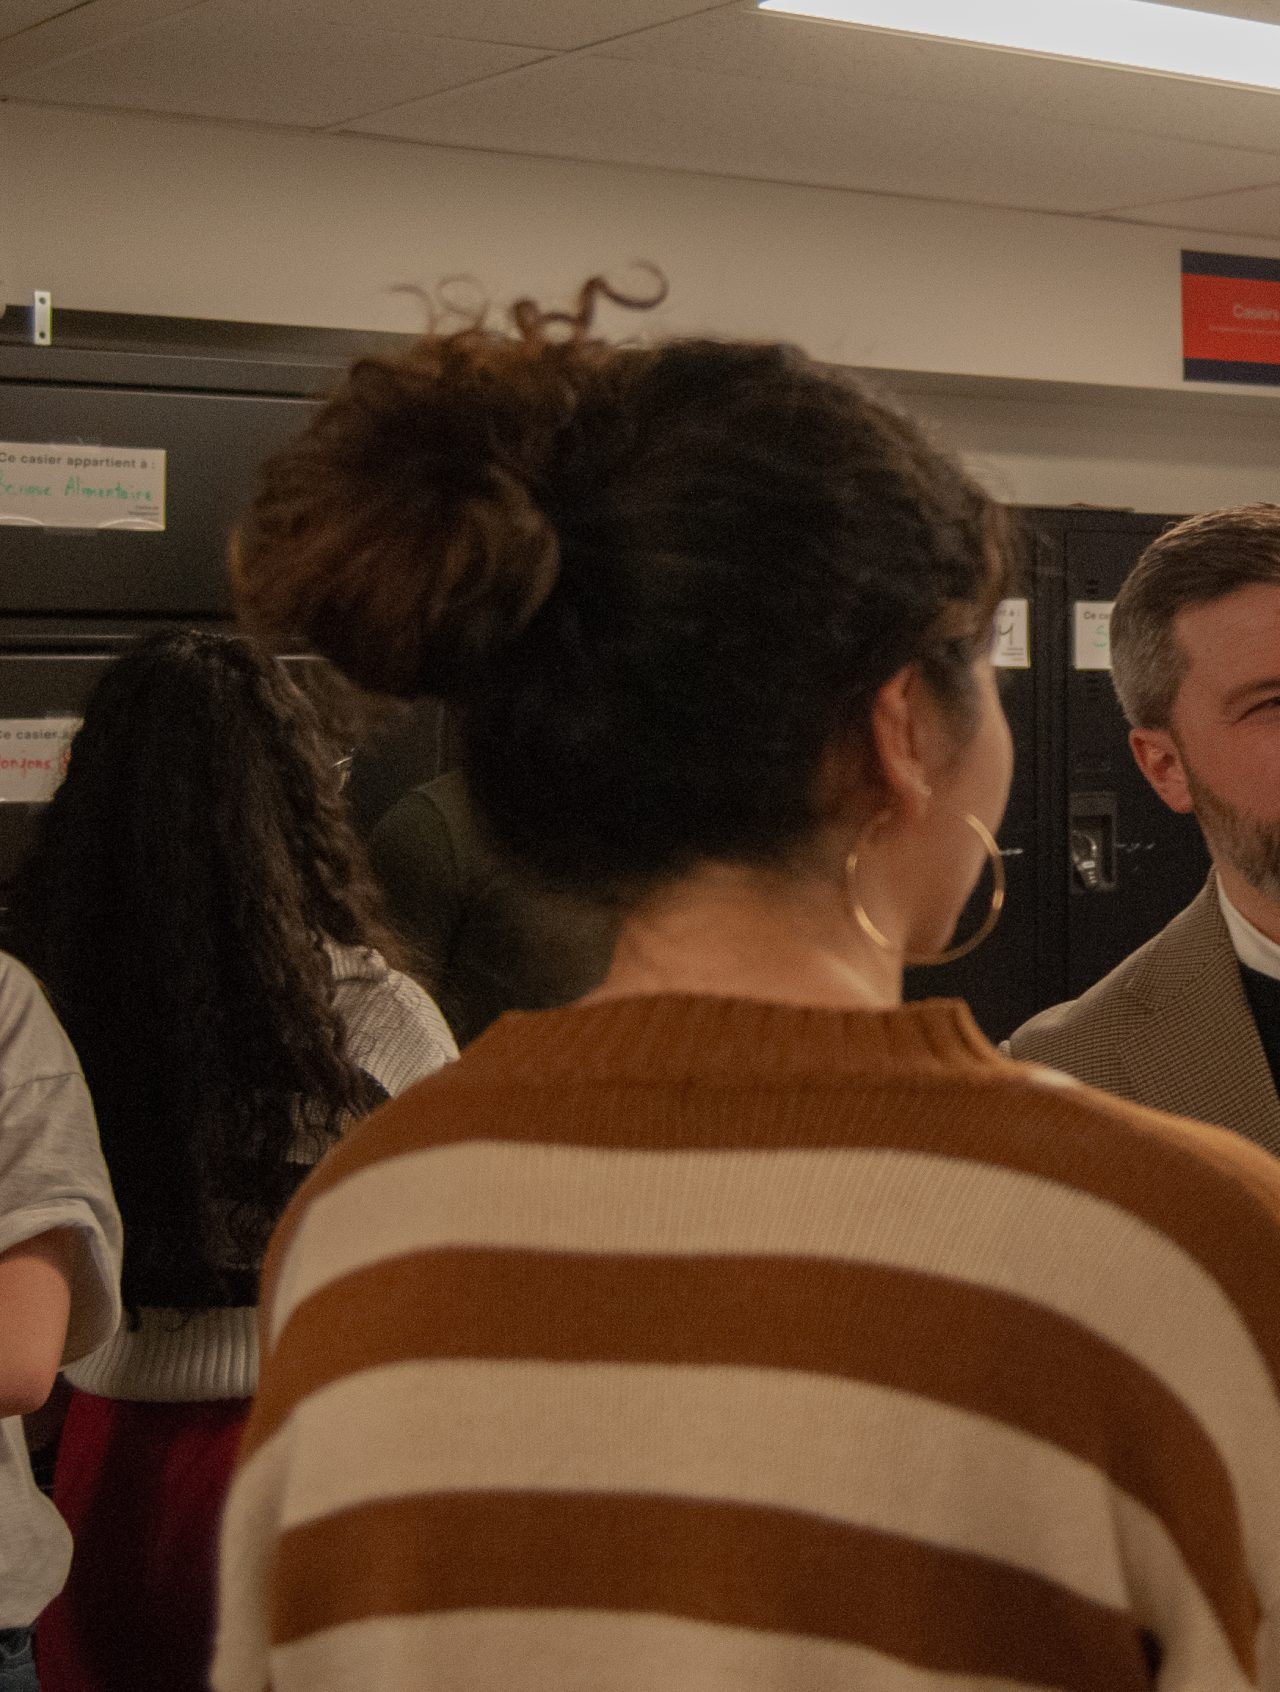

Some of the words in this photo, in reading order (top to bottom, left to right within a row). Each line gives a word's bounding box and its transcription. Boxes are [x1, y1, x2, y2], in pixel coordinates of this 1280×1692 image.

[20, 453, 62, 465] casier
[67, 456, 135, 469] appartient
[140, 459, 147, 469] à
[16, 729, 57, 740] casier
[0, 758, 51, 779] onjons
